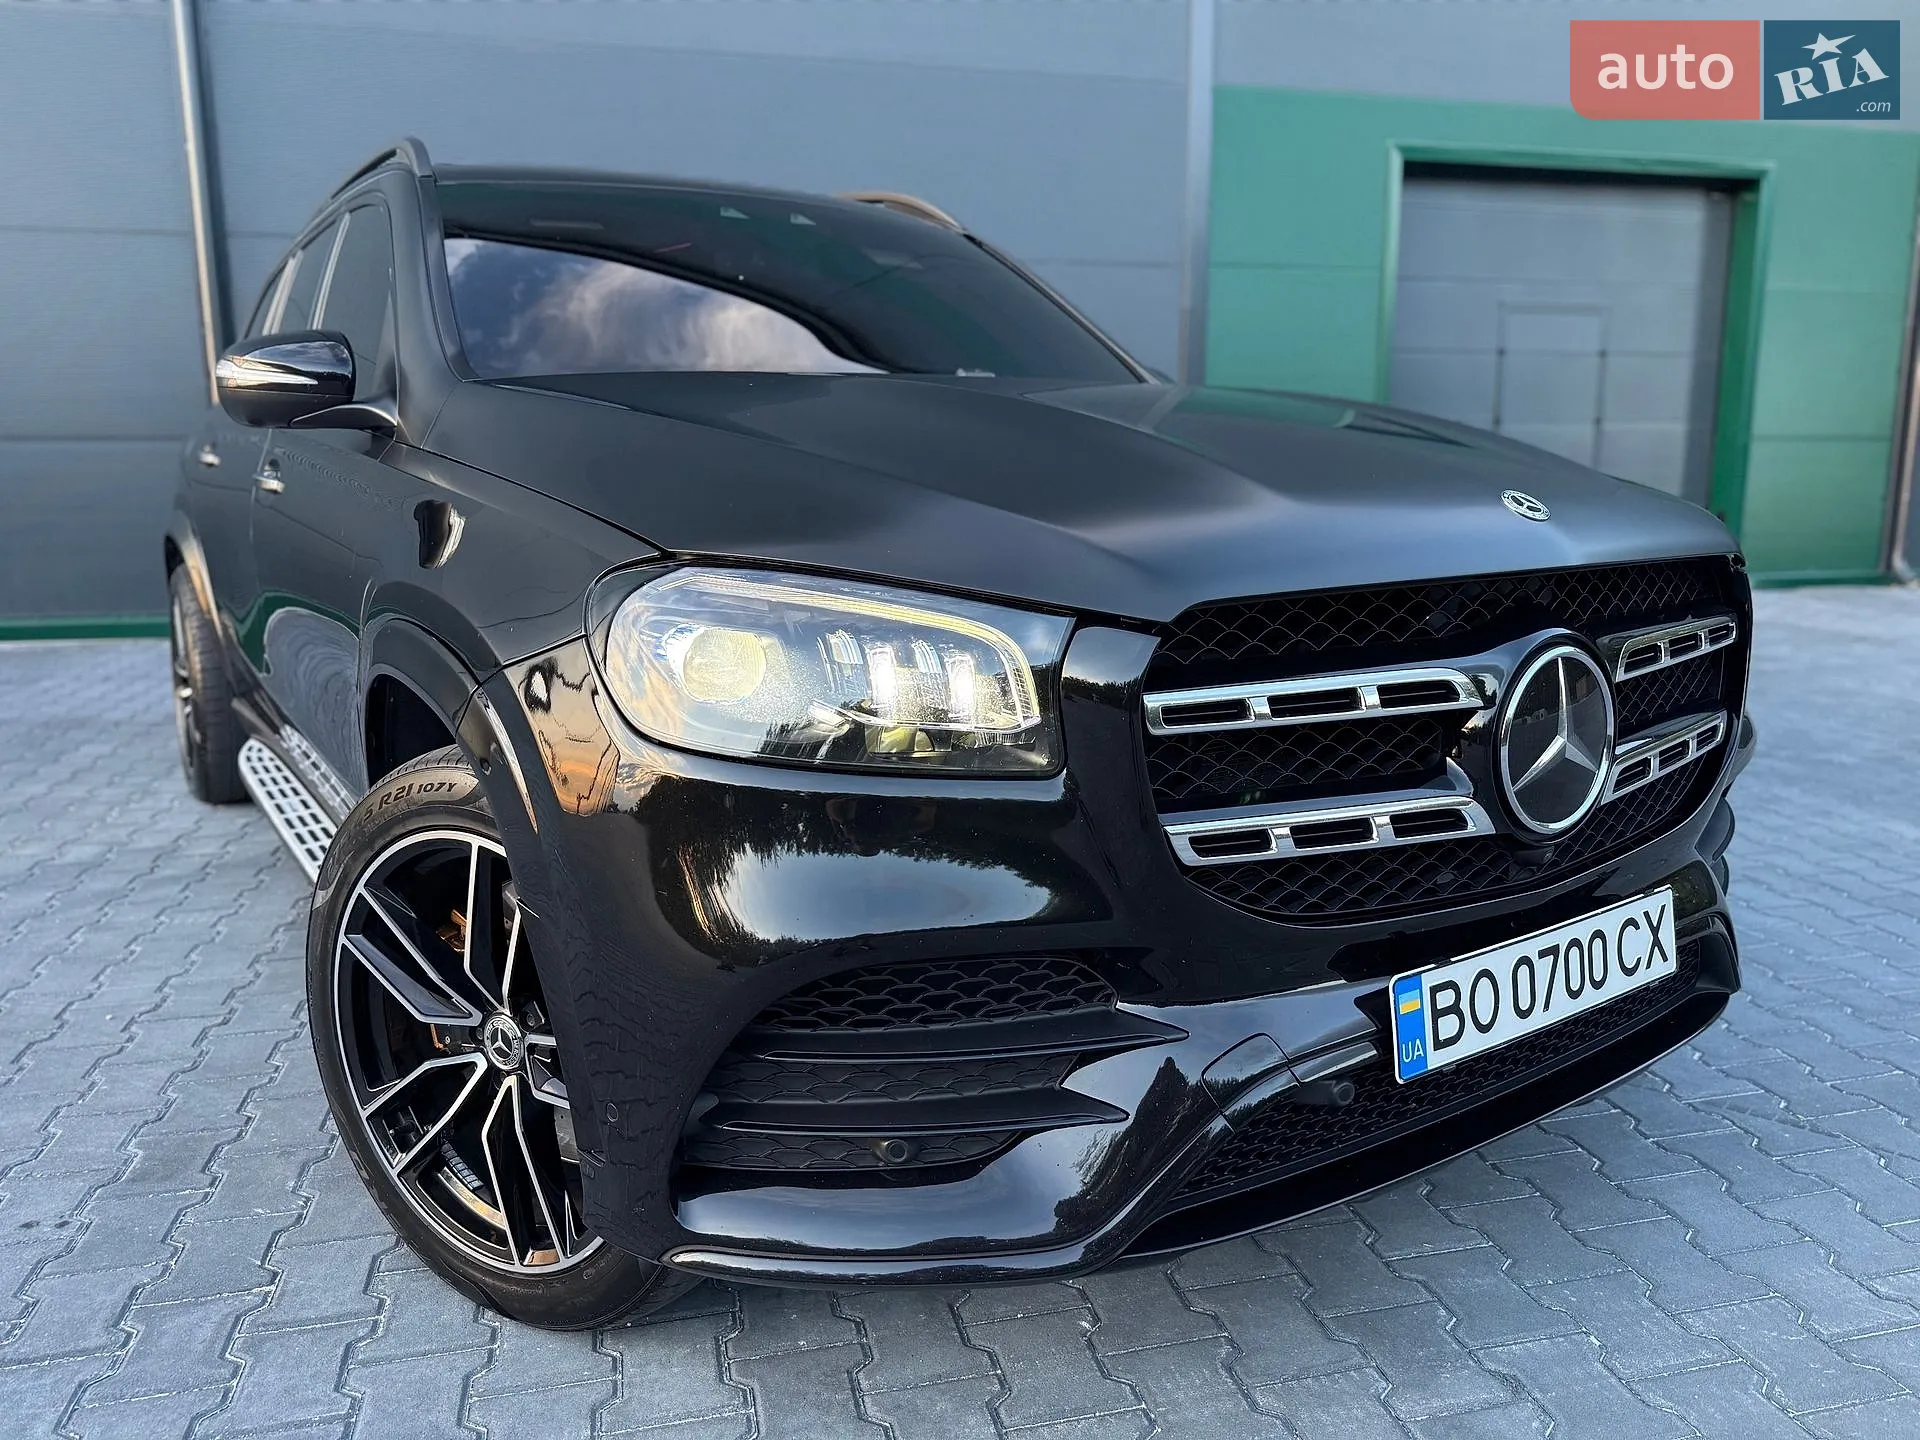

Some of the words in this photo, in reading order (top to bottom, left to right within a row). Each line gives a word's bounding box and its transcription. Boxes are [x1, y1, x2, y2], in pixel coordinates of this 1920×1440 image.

[378, 782, 415, 811] R21
[1429, 968, 1501, 1052] BO
[1511, 928, 1609, 1020] 0700
[1616, 903, 1669, 977] CX
[1401, 1037, 1426, 1064] UA
